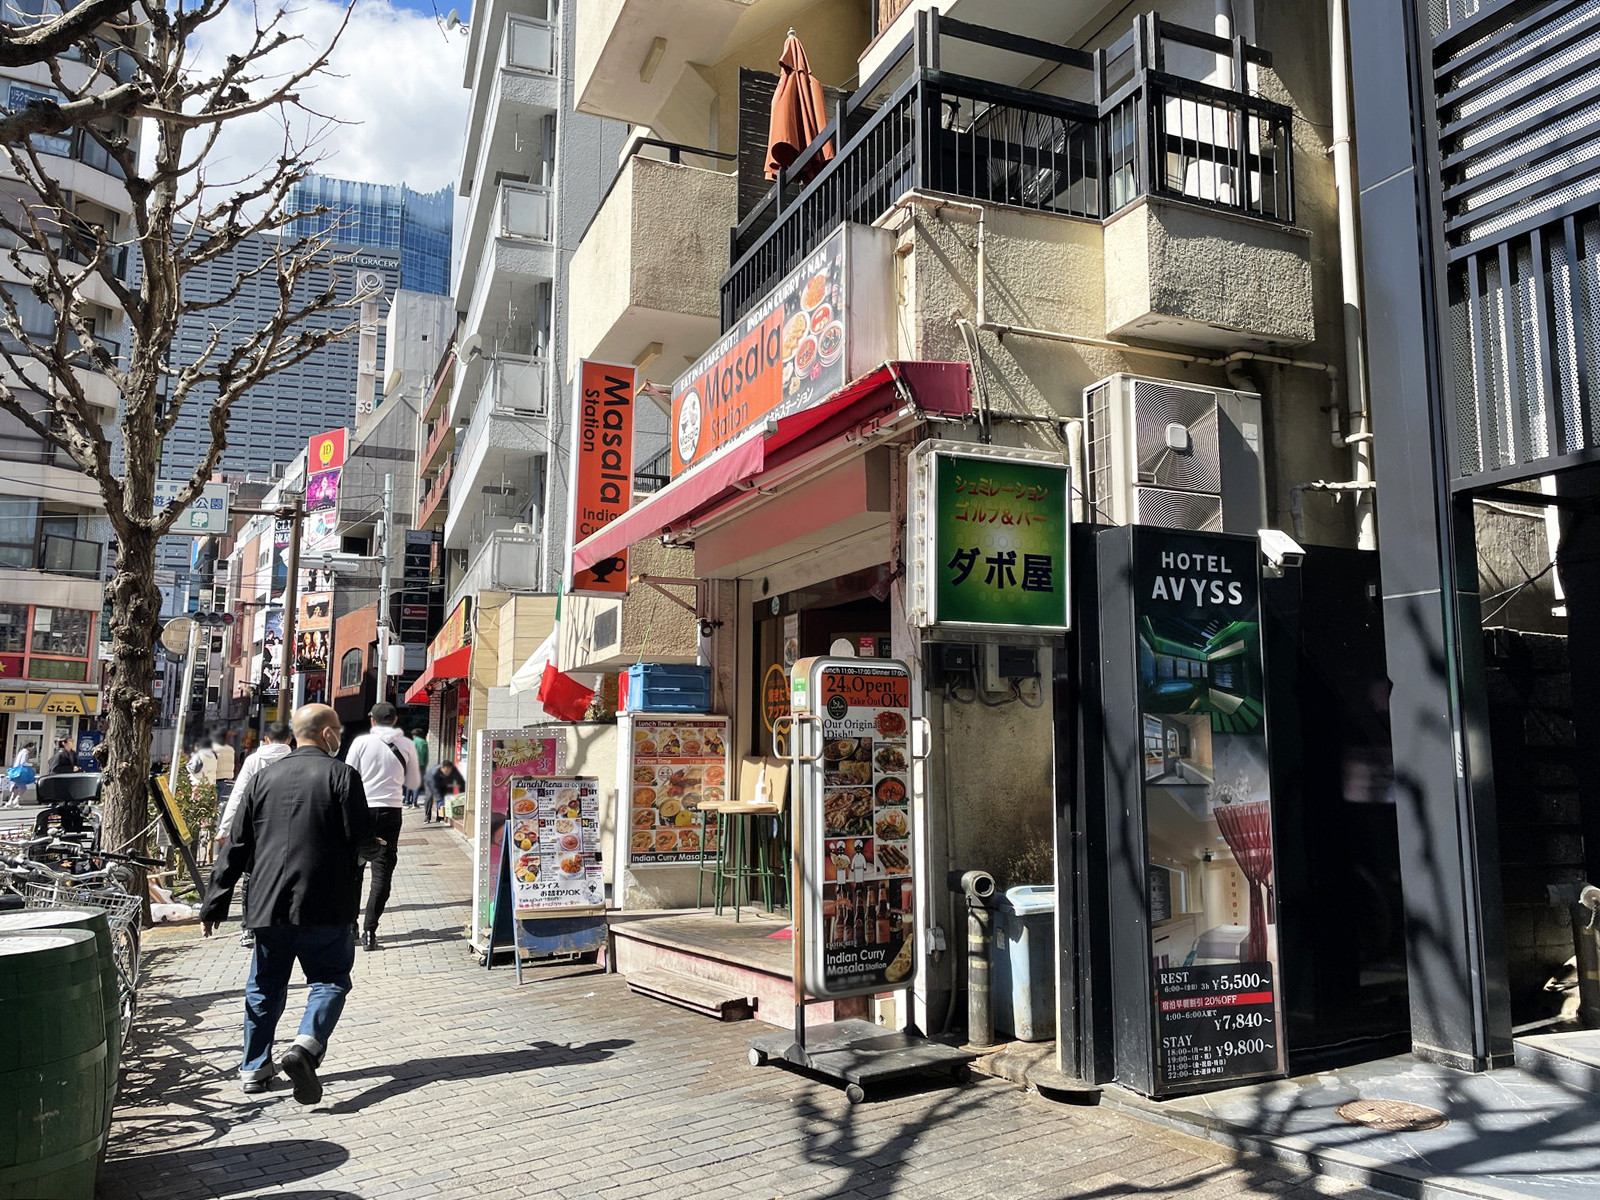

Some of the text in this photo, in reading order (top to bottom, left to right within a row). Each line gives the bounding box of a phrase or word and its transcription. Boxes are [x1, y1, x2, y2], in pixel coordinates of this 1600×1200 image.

[361, 257, 399, 268] GRACERY
[680, 371, 692, 393] EAT
[704, 347, 720, 372] TAKE
[747, 296, 773, 333] INDIAN
[774, 279, 800, 307] CURRY
[807, 248, 827, 276] NAN
[704, 323, 782, 418] Masala
[357, 401, 373, 413] 59
[583, 388, 600, 452] Station
[711, 401, 748, 444] Station
[600, 375, 630, 504] Masala
[955, 475, 1048, 501] シュミレーション
[583, 508, 622, 521] India
[947, 547, 1054, 592] ダボ屋
[1162, 551, 1232, 573] HOTEL
[1151, 576, 1243, 607] AVYSS
[851, 676, 897, 697] Open!
[849, 697, 865, 705] Take
[881, 693, 907, 708] OK!
[824, 719, 882, 732] Our Original
[826, 730, 853, 740] Dish!!
[632, 853, 656, 862] Indian
[657, 853, 677, 862] Curry
[678, 853, 707, 861] Masaa
[519, 882, 560, 891] ナン&ライス
[827, 950, 886, 965] Indian Curry
[826, 963, 887, 976] Masala Station
[1160, 972, 1189, 985] REST
[1162, 1035, 1193, 1049] STAY
